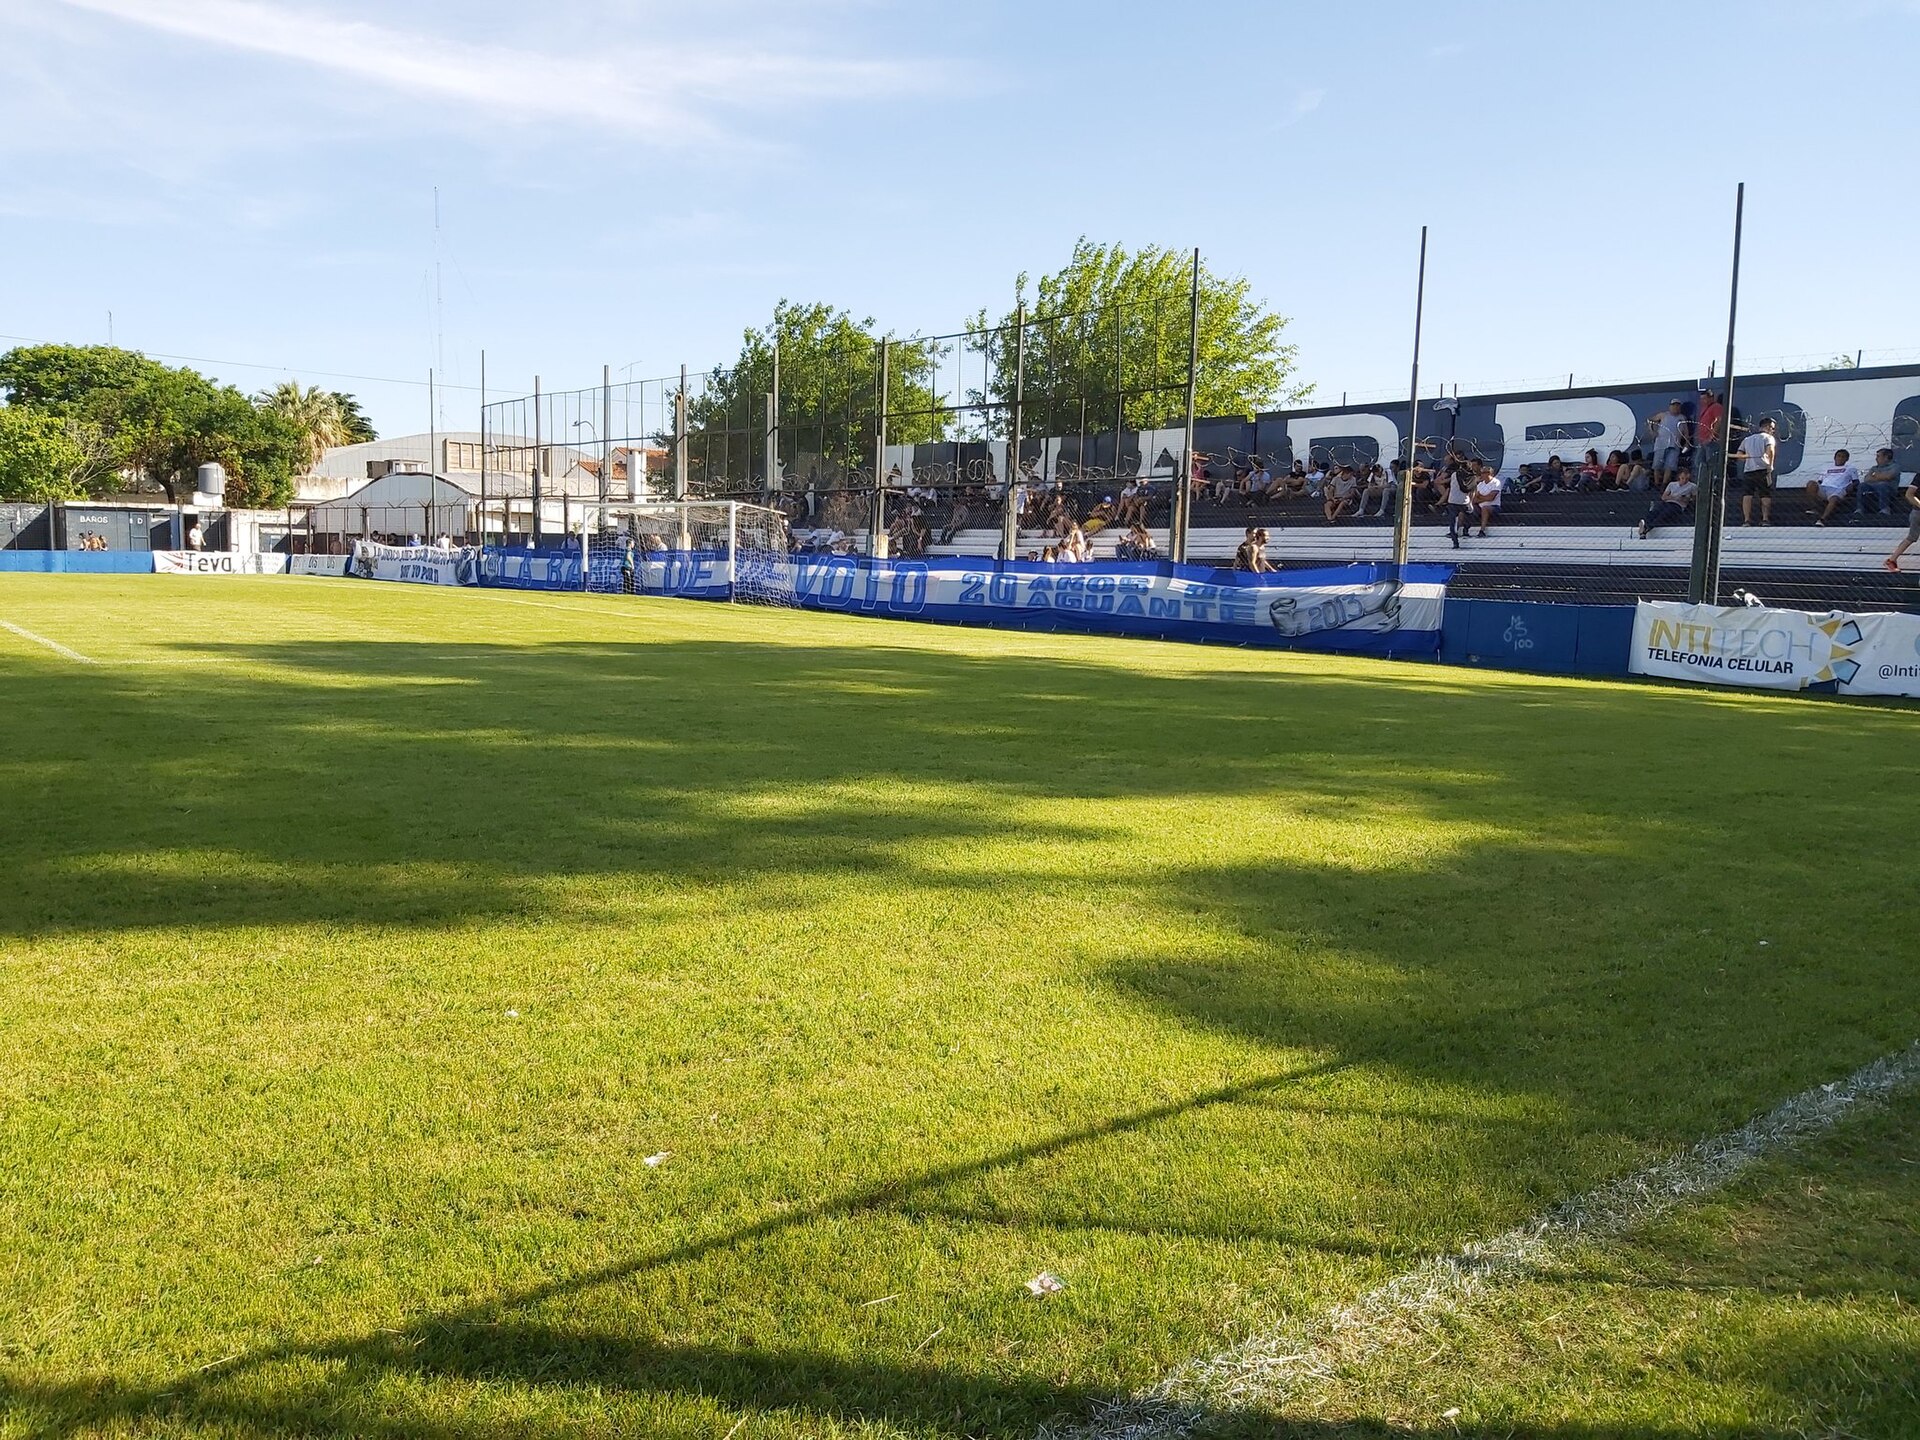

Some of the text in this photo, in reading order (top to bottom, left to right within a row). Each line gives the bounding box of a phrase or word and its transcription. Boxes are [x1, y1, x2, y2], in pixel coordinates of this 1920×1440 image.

[185, 552, 232, 572] Teva
[500, 549, 534, 588] LA
[663, 552, 716, 595] DE
[958, 573, 1019, 606] 20
[1027, 591, 1256, 625] AGUANTE
[1649, 618, 1816, 662] INTITECH
[1648, 648, 1793, 674] TELEFONIA CELULAR
[1878, 664, 1920, 680] @Inti
